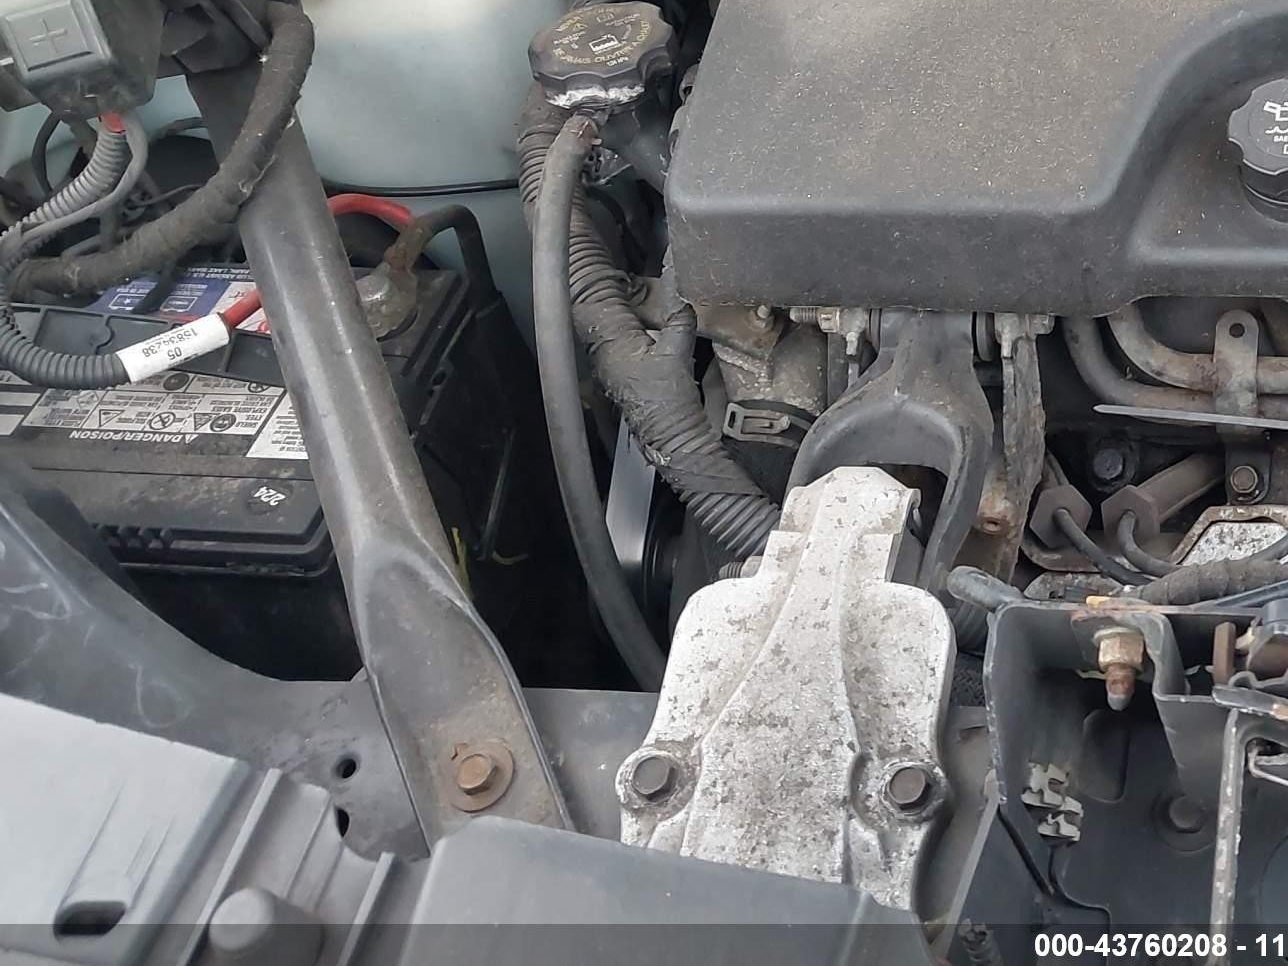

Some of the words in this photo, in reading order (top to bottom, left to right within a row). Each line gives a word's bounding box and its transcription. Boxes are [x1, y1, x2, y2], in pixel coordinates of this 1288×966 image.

[1273, 135, 1288, 143] SAE
[167, 346, 183, 361] 05
[69, 430, 184, 443] DANGER/POISON
[253, 486, 286, 506] 2/24
